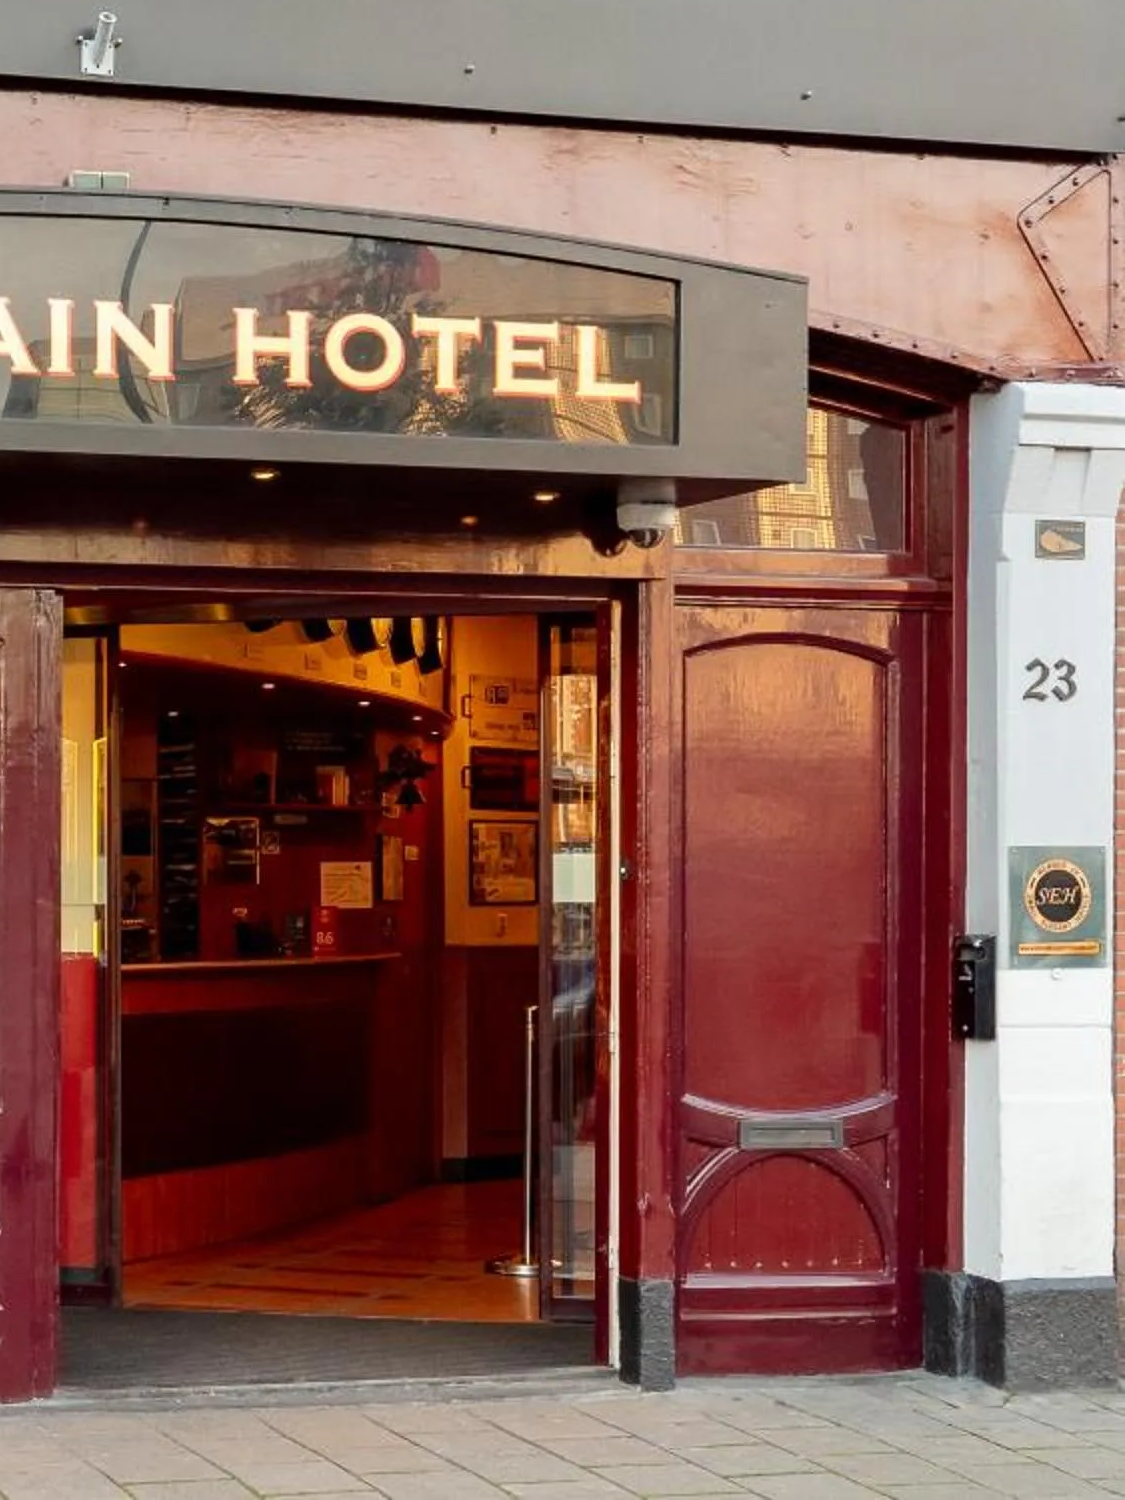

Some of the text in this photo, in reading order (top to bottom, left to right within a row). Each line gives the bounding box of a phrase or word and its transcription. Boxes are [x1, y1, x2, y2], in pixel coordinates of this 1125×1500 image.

[232, 307, 641, 405] HOTEL
[1022, 658, 1077, 702] 23
[1036, 885, 1081, 906] SEH
